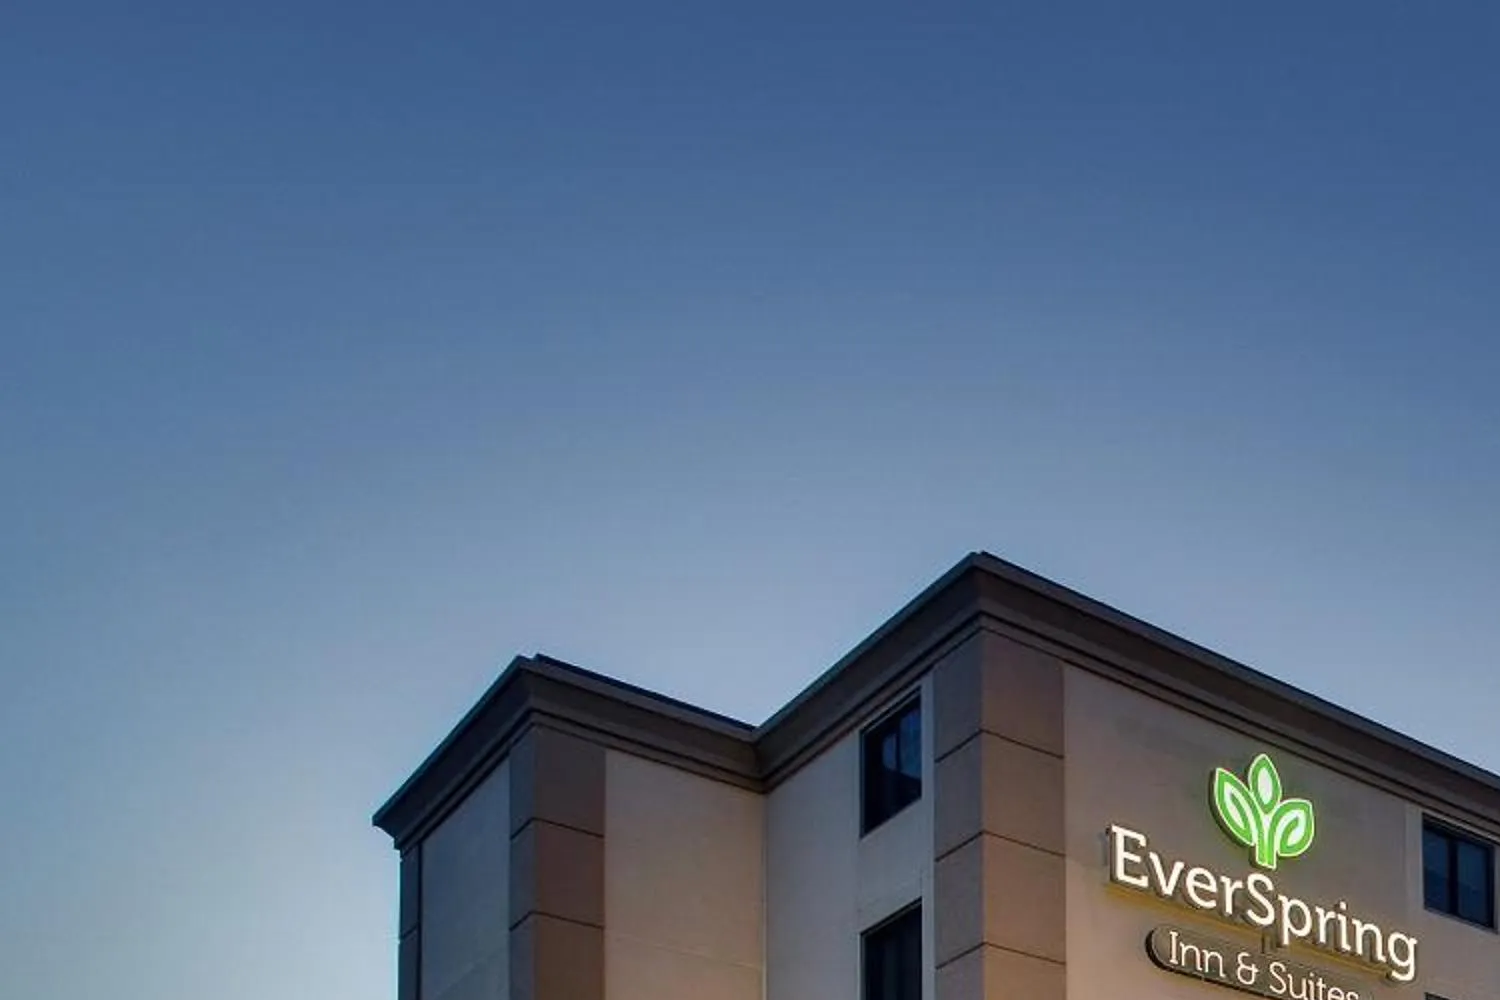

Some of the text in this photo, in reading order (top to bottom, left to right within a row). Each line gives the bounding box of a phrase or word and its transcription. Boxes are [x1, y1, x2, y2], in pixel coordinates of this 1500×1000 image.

[1110, 824, 1418, 981] EverSpring
[1169, 931, 1226, 978] Inn
[1237, 952, 1259, 985] &
